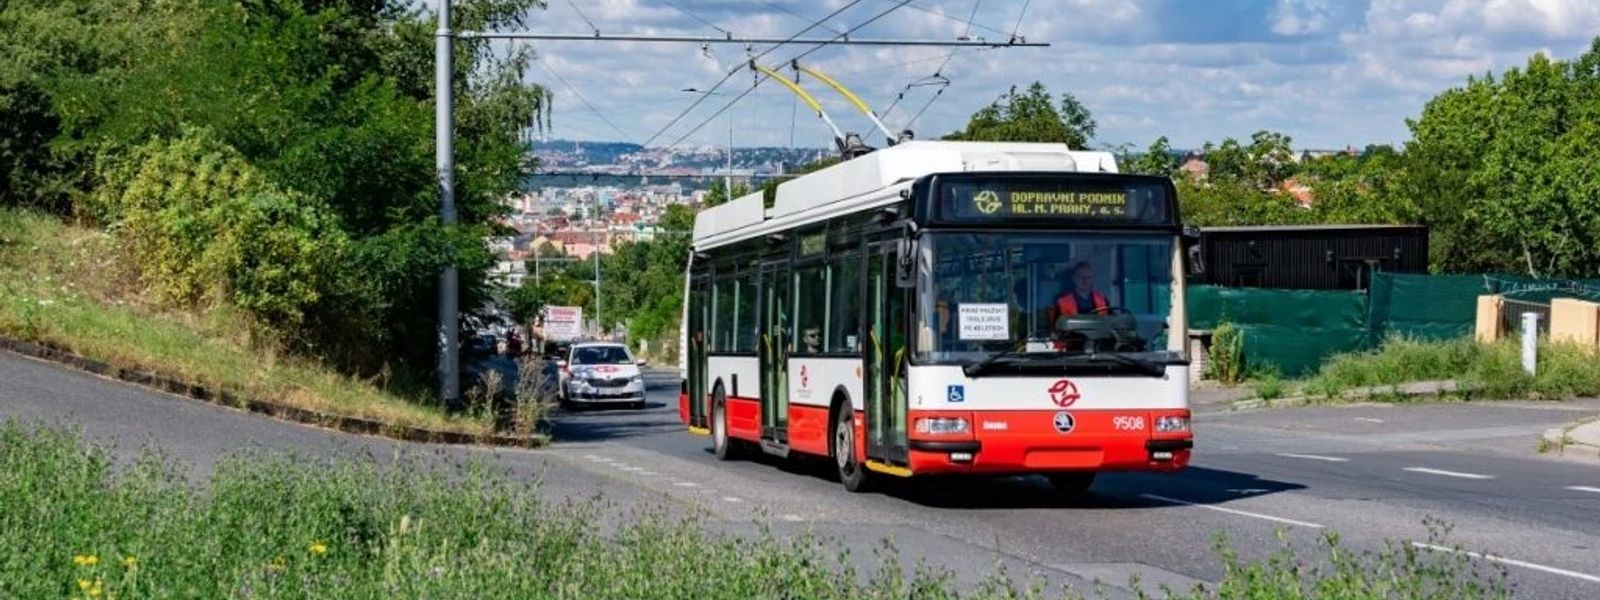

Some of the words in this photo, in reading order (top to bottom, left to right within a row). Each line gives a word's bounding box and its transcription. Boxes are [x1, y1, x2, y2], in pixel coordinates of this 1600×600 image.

[1079, 193, 1125, 204] PODNIK
[1012, 203, 1032, 214] HL.
[1034, 204, 1047, 214] M.
[1114, 206, 1125, 215] s.
[1113, 416, 1145, 430] 9508
